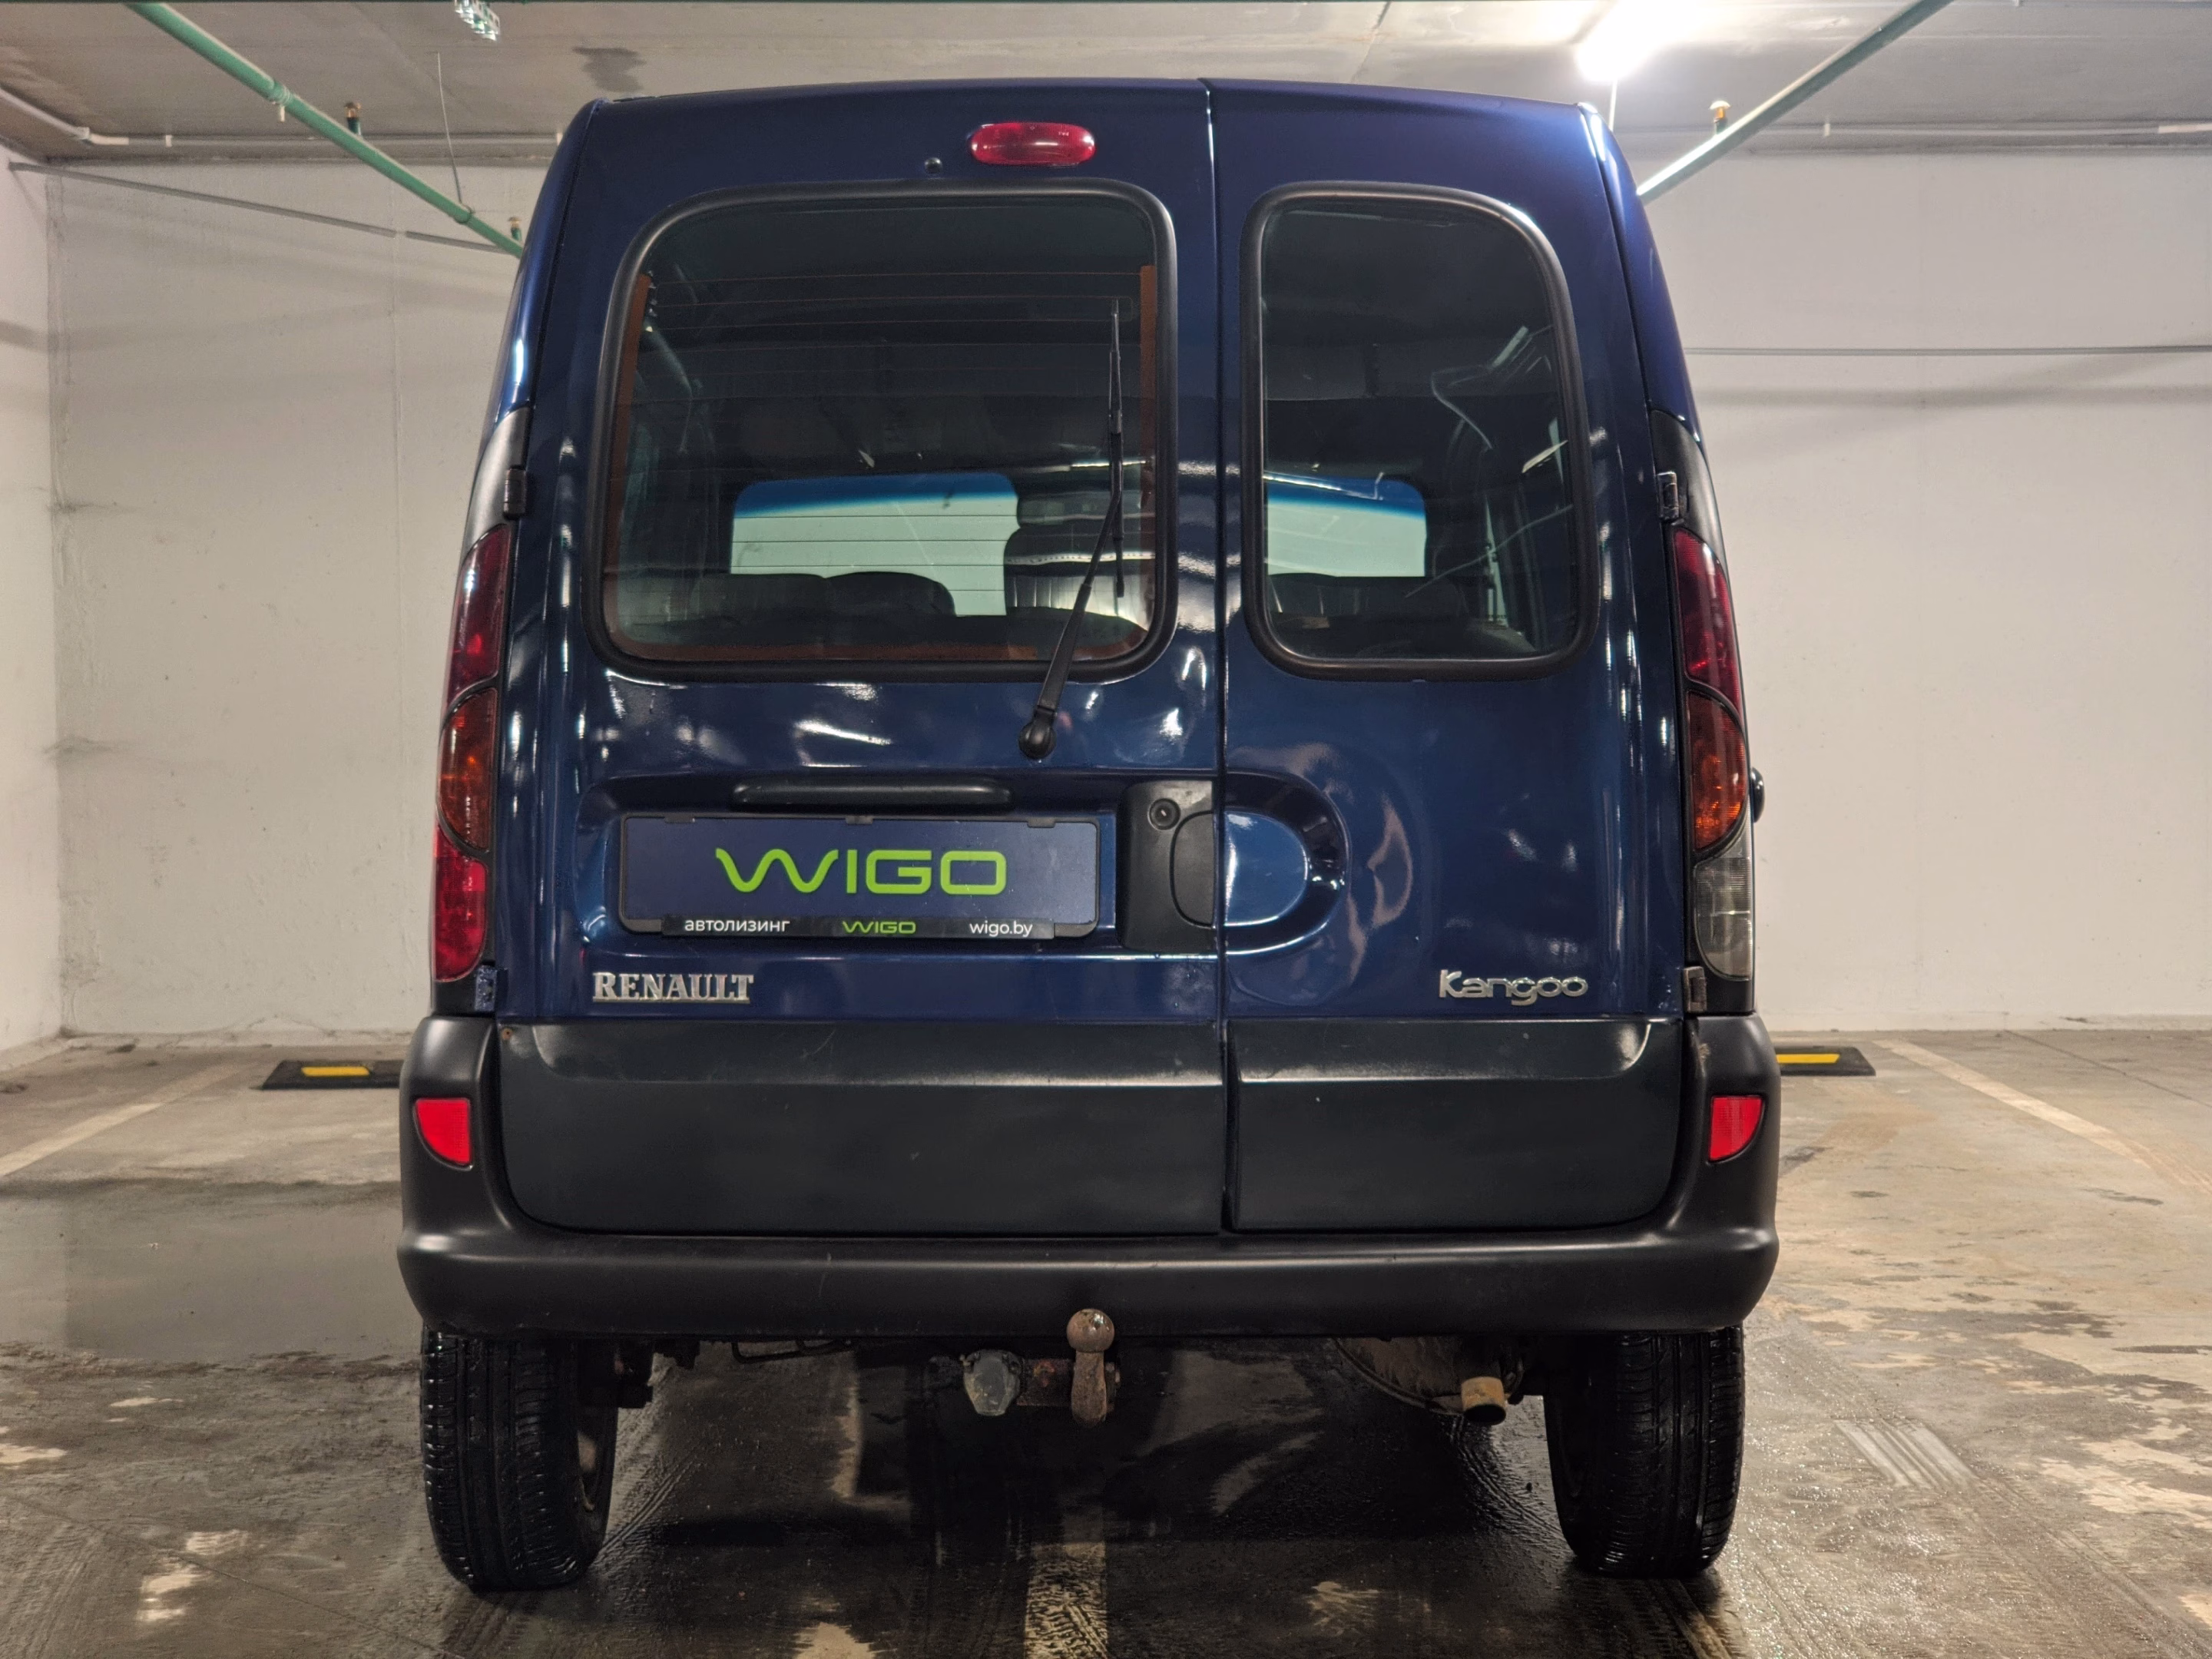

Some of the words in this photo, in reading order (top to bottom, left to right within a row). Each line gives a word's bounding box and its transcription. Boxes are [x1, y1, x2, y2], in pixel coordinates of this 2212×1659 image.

[716, 848, 1007, 896] WIGO
[684, 917, 791, 933] автолизинг
[842, 920, 916, 935] WIGO
[969, 920, 1033, 938] wigo.by
[592, 971, 754, 1003] RENAULT
[1439, 969, 1588, 1006] Kangoo
